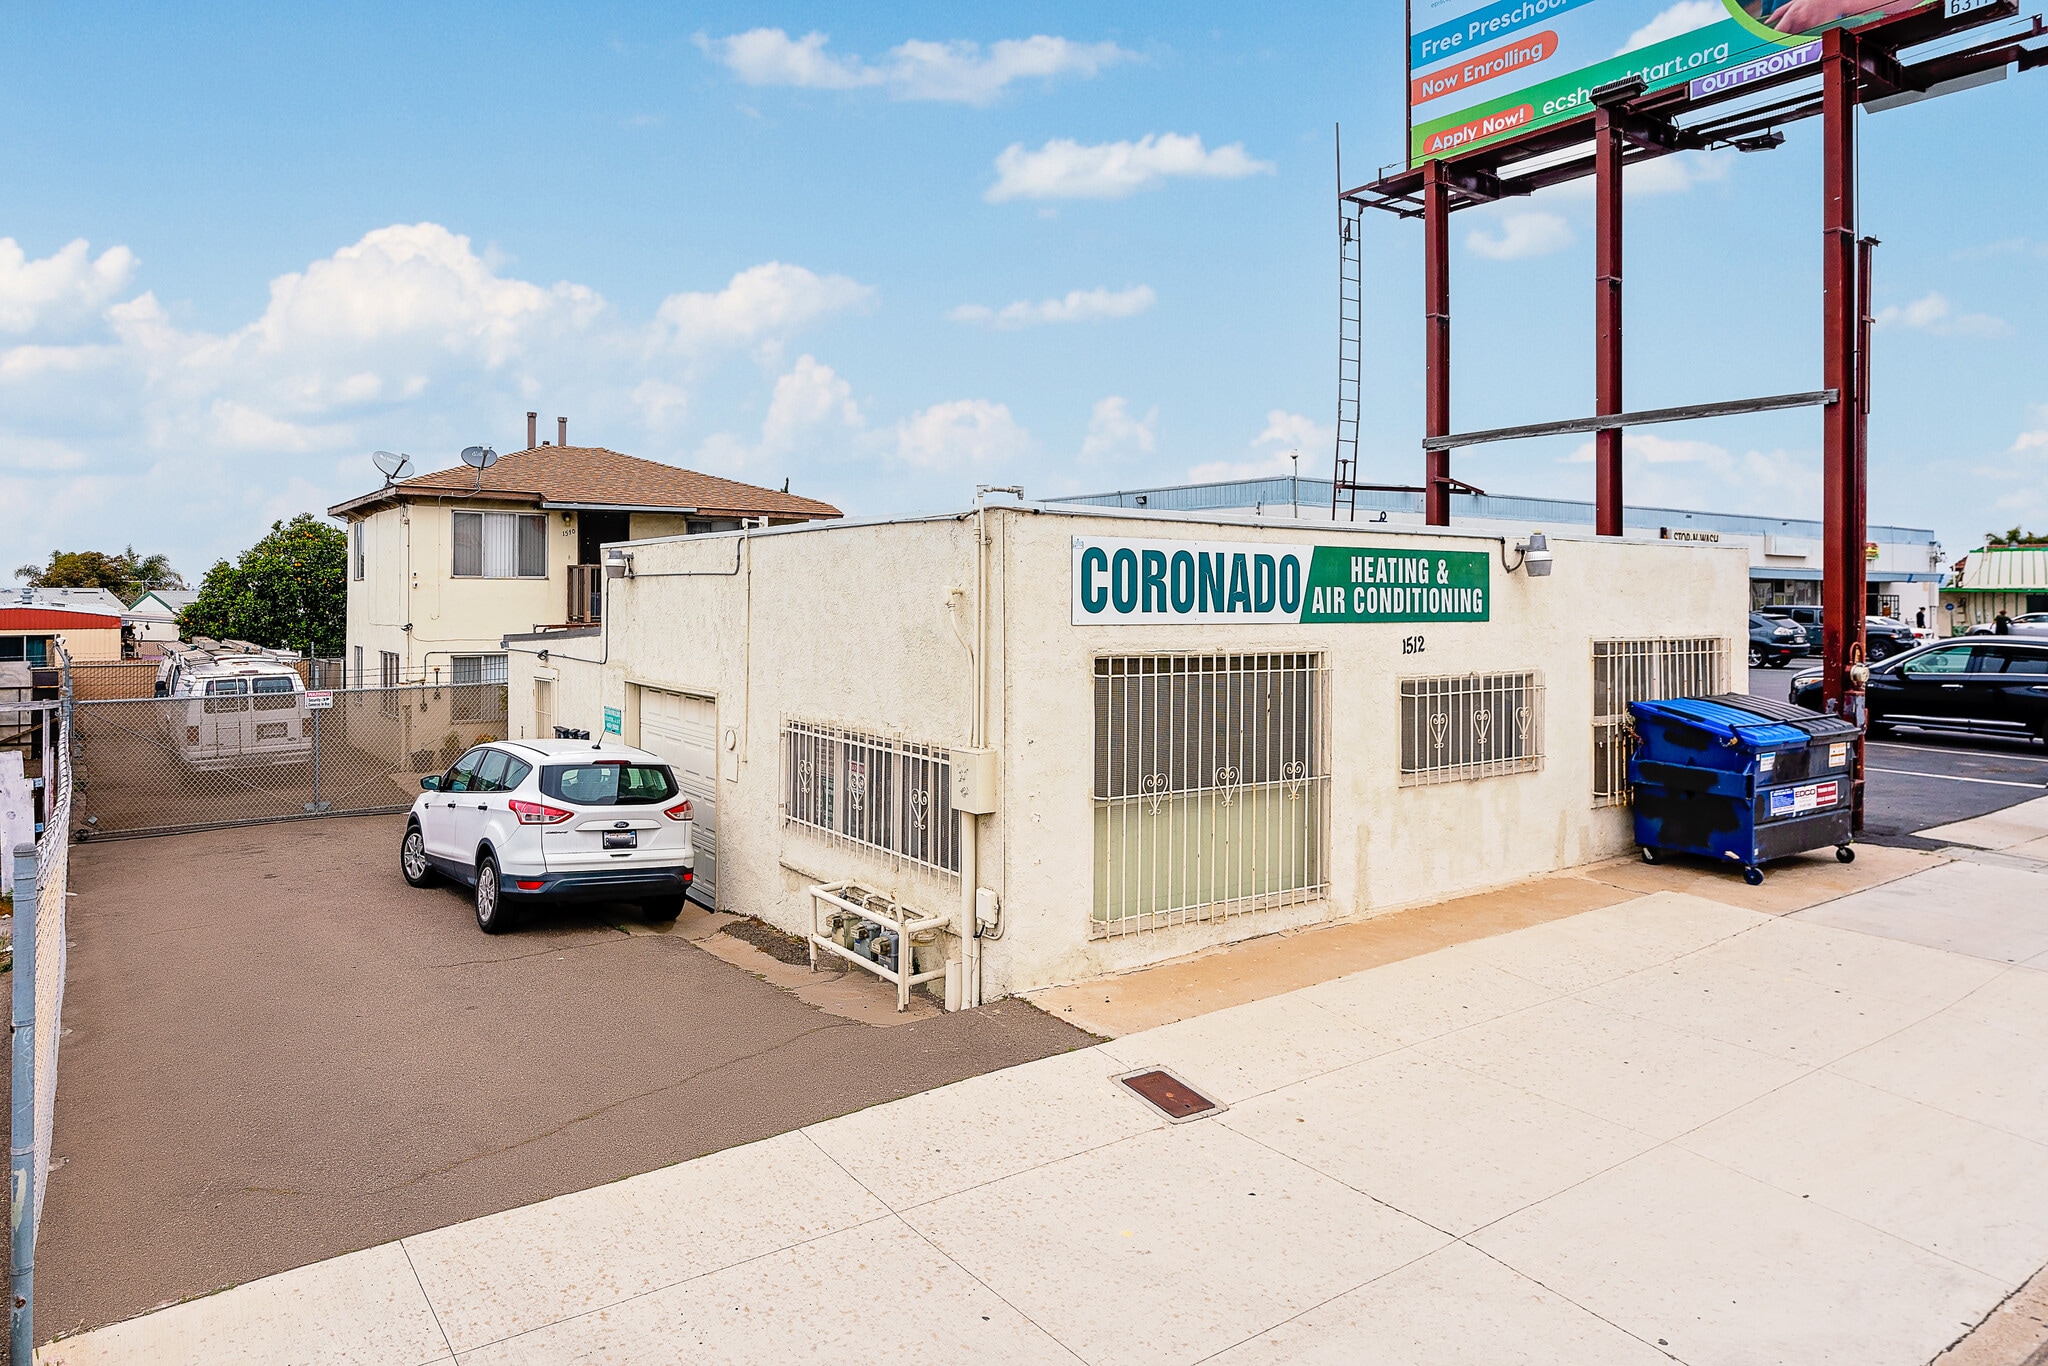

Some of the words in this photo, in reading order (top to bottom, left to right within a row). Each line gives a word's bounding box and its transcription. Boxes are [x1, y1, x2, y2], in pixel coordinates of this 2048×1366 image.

[1422, 32, 1463, 59] Free
[1469, 0, 1567, 41] Preschoo
[1422, 73, 1459, 98] Now
[1464, 42, 1543, 83] Enrolling
[1543, 42, 1729, 115] ecshtart.org
[1701, 44, 1815, 94] OUTFRONT
[1431, 126, 1478, 151] Apply
[1482, 107, 1525, 136] Now!
[1080, 546, 1300, 615] CORONADO
[1350, 556, 1429, 585] HEATING
[1436, 558, 1450, 585] &
[1312, 587, 1346, 615] AIR
[1353, 587, 1484, 615] CONDITIONING
[1402, 636, 1425, 655] 1512
[1795, 788, 1816, 798] EDCO
